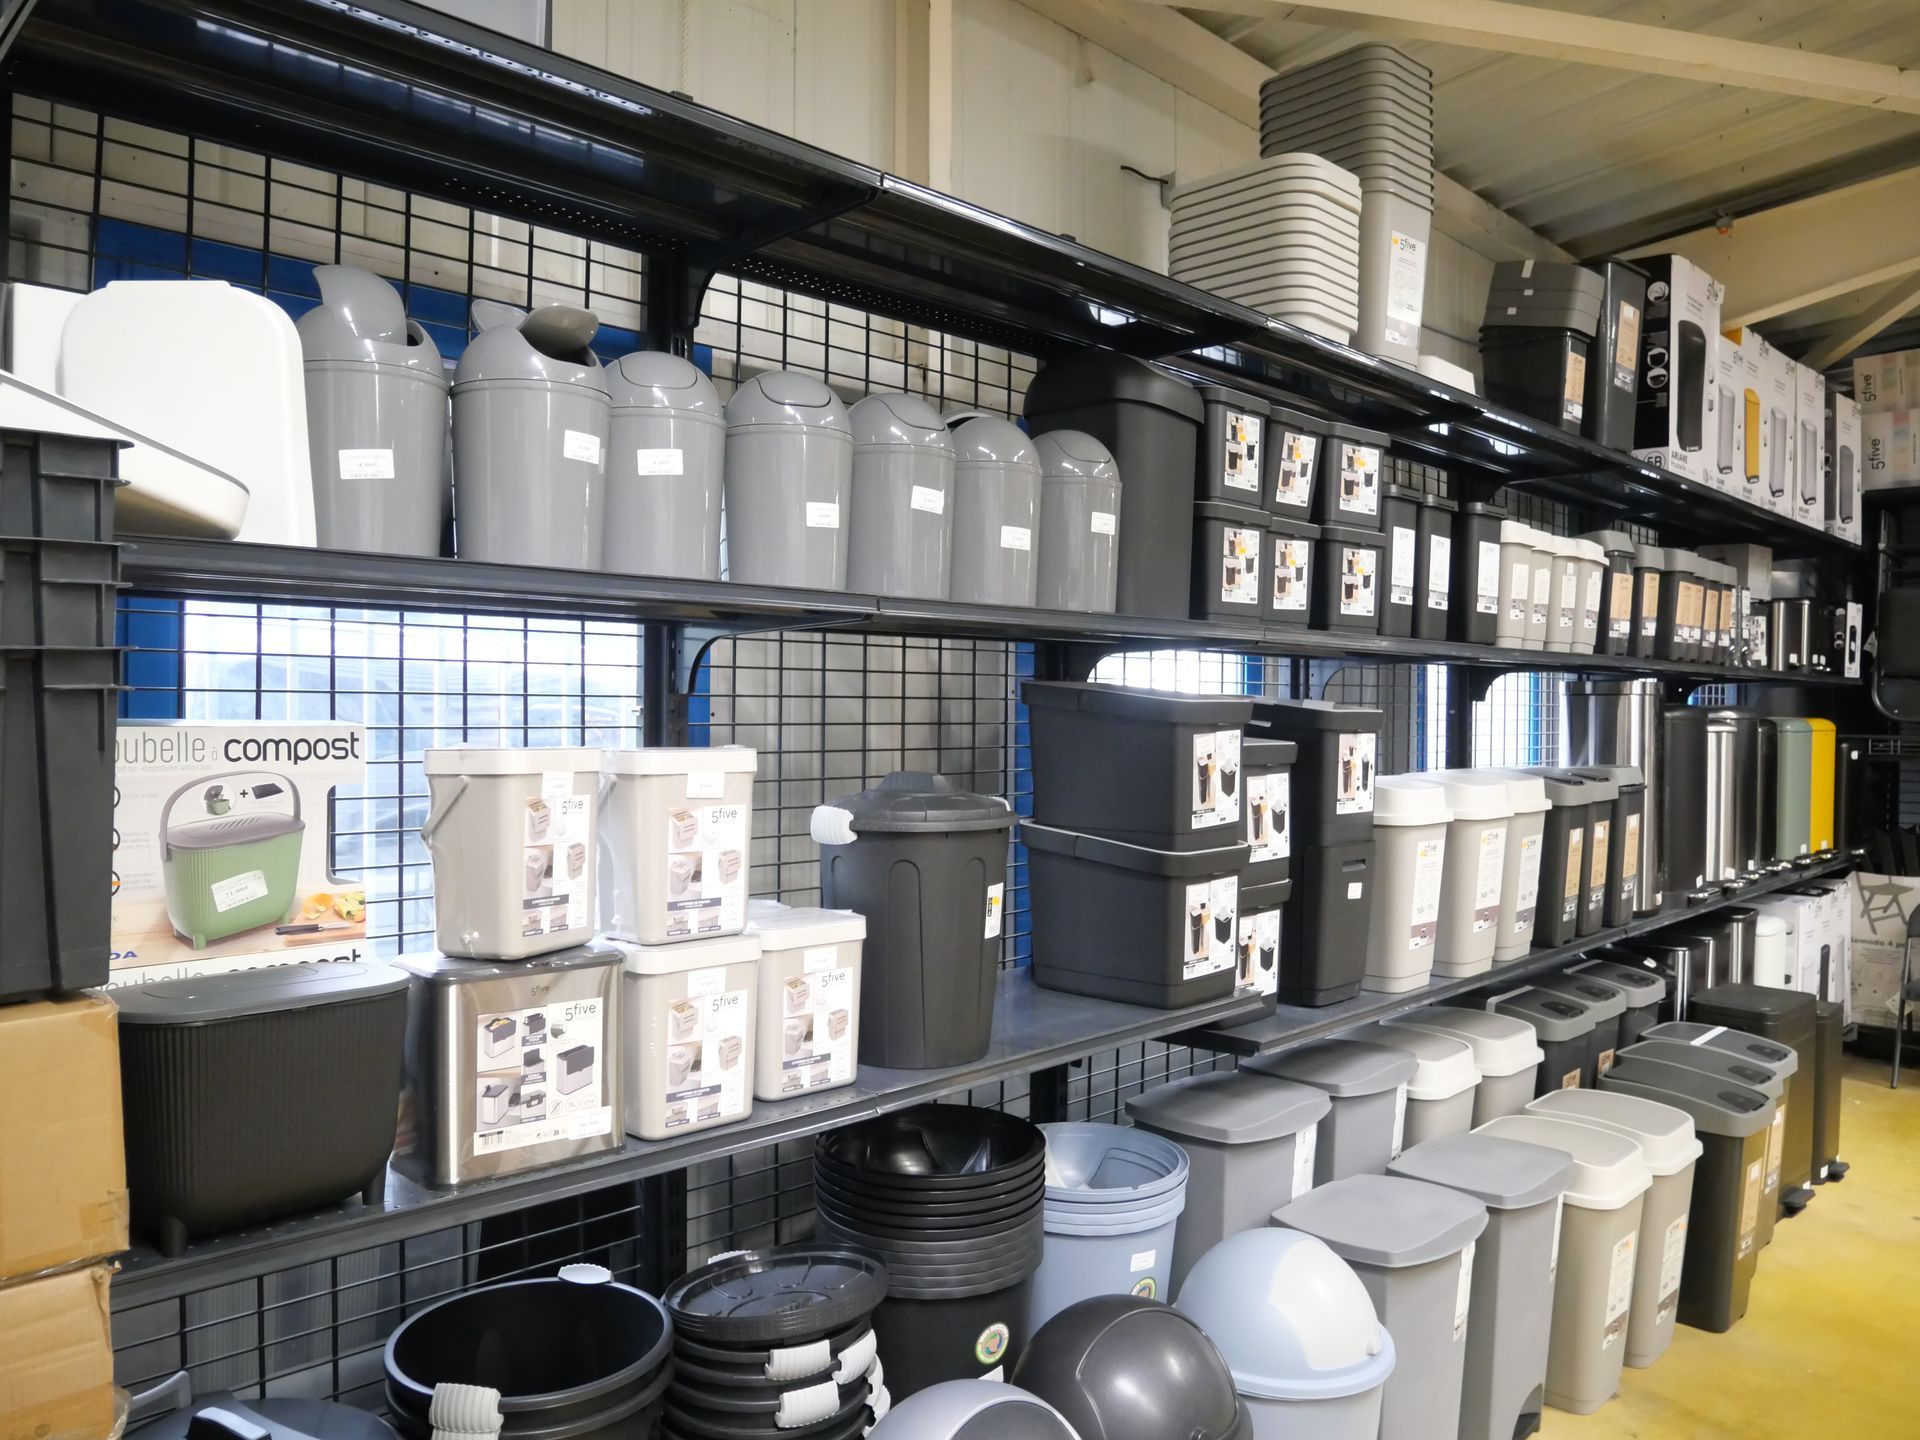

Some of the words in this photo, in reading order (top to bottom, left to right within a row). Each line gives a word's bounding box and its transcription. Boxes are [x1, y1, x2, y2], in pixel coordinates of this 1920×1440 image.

[1862, 374, 1877, 402] 5five
[1868, 438, 1885, 470] 5five
[224, 731, 359, 765] compost
[711, 808, 738, 824] 5five
[821, 971, 845, 988] 5five
[565, 1002, 597, 1022] 5five
[712, 994, 739, 1012] 5five
